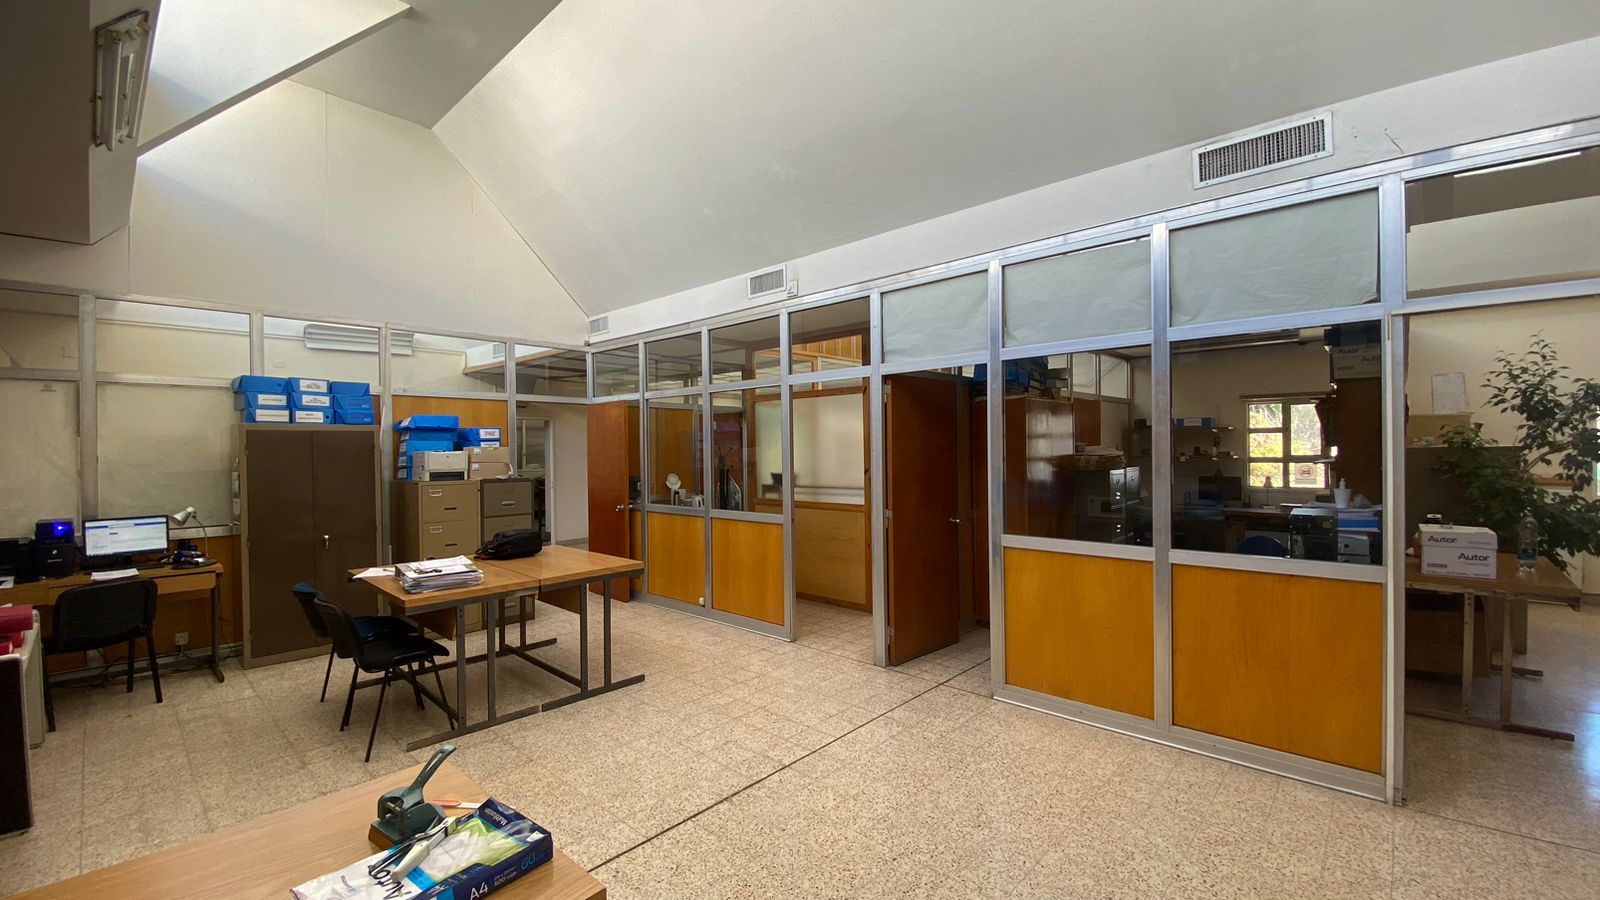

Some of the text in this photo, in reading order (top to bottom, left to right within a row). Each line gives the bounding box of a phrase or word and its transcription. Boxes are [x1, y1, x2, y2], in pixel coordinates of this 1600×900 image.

[1427, 535, 1457, 543] Autor
[1457, 552, 1490, 561] Autor
[470, 881, 489, 900] A4
